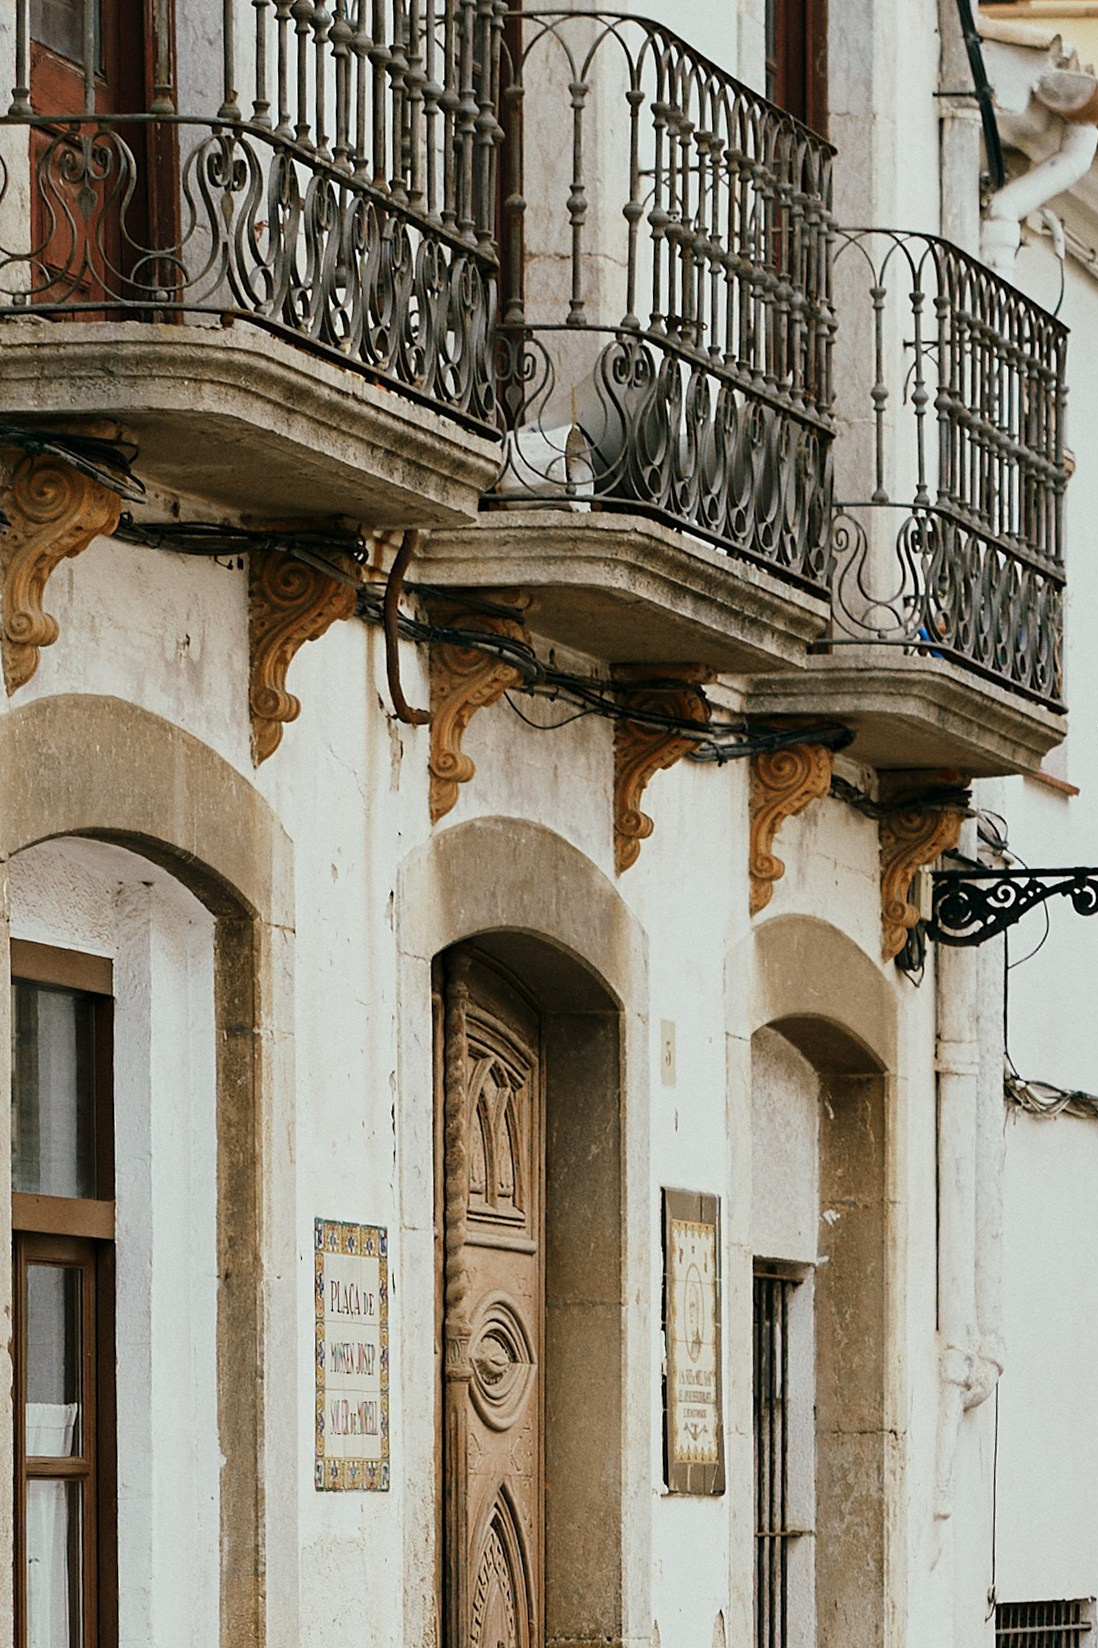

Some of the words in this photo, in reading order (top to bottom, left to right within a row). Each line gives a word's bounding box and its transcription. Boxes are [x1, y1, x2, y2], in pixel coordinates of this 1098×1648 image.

[330, 1280, 361, 1318] PLAÇA
[363, 1292, 375, 1315] DE
[356, 1343, 376, 1375] JOSEP
[350, 1412, 357, 1435] DE
